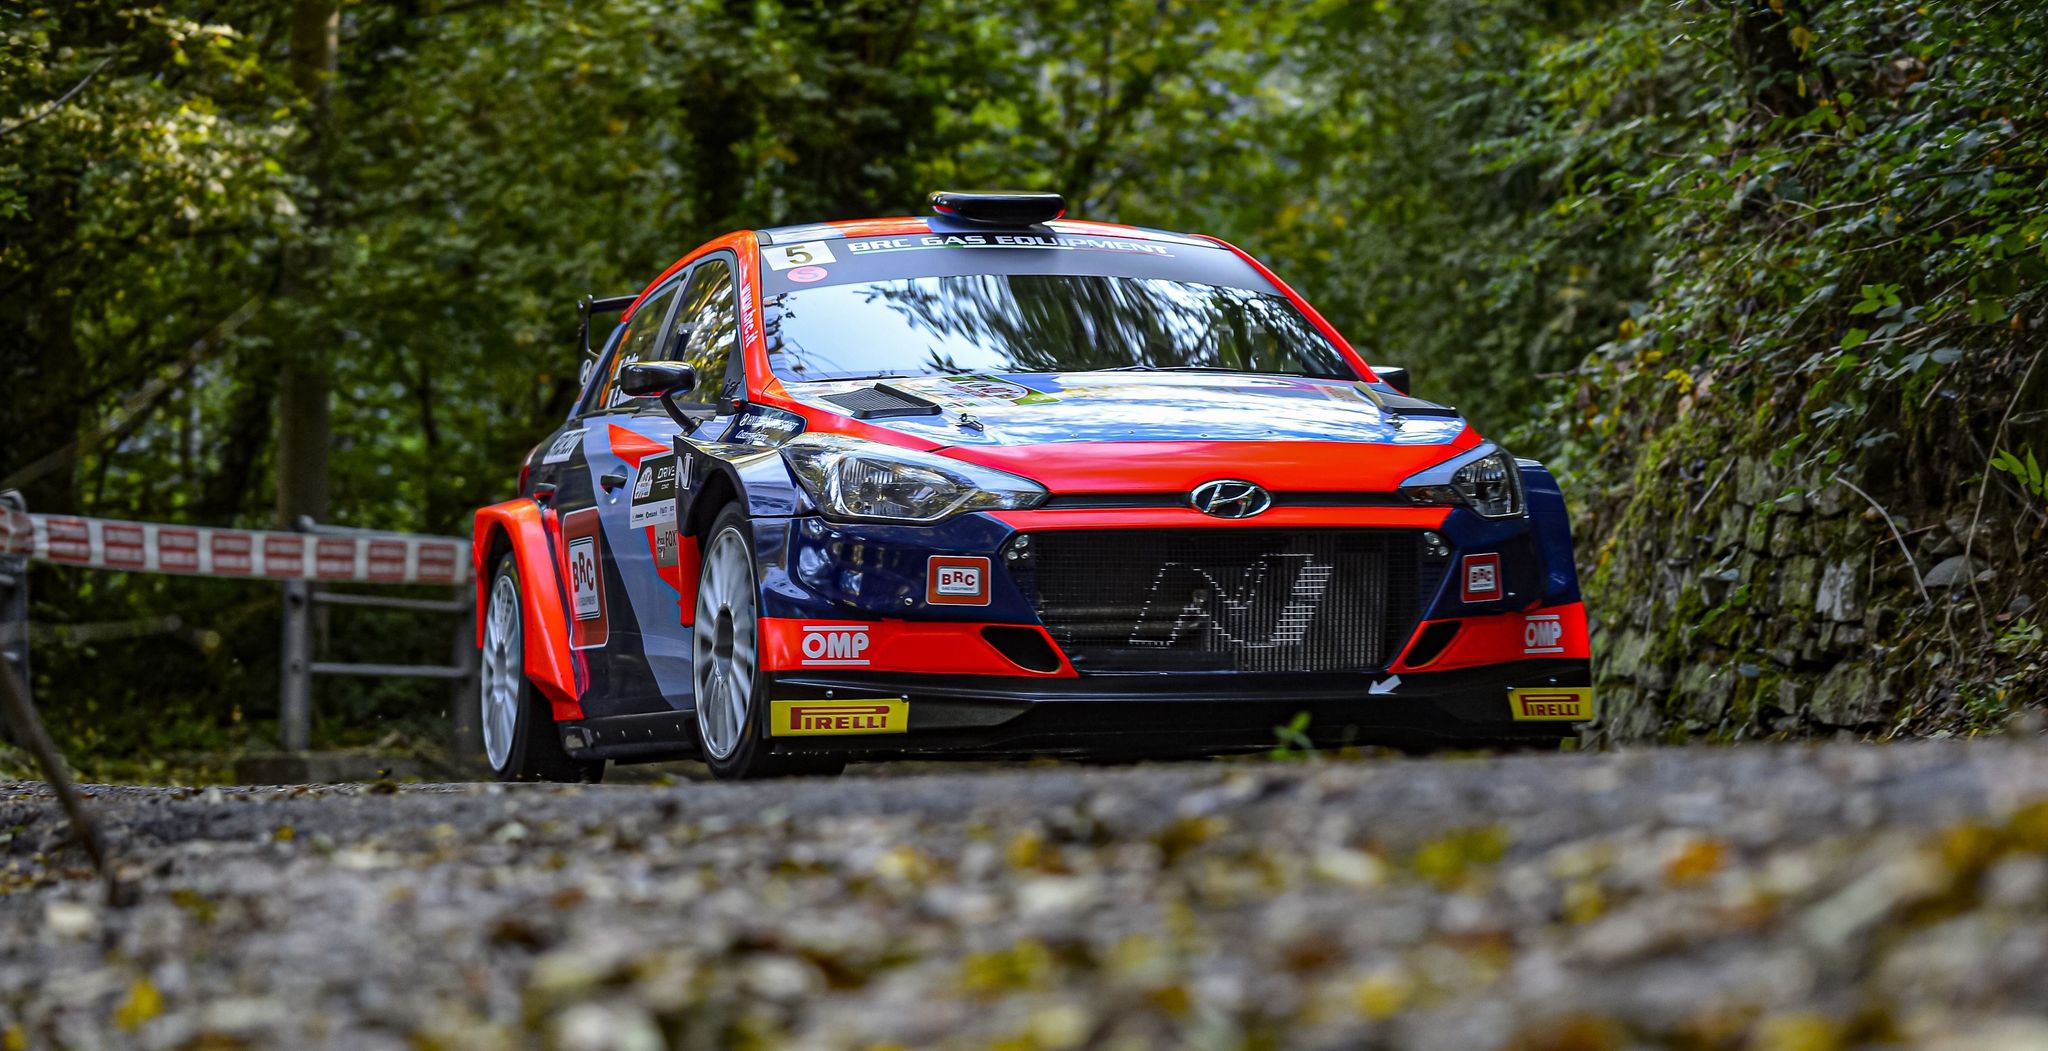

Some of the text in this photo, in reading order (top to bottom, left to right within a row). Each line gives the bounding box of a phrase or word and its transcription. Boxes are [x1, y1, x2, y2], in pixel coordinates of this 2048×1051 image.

[785, 245, 813, 264] 5
[847, 235, 1168, 254] BRC GAS EQUIPMENT
[741, 282, 759, 349] www.brc.it
[572, 551, 594, 593] BRC
[942, 571, 975, 586] BRC
[801, 631, 870, 659] OMP
[1524, 621, 1563, 648] OMP
[1519, 693, 1580, 716] PIRELLI
[790, 705, 890, 730] PIRELLI
